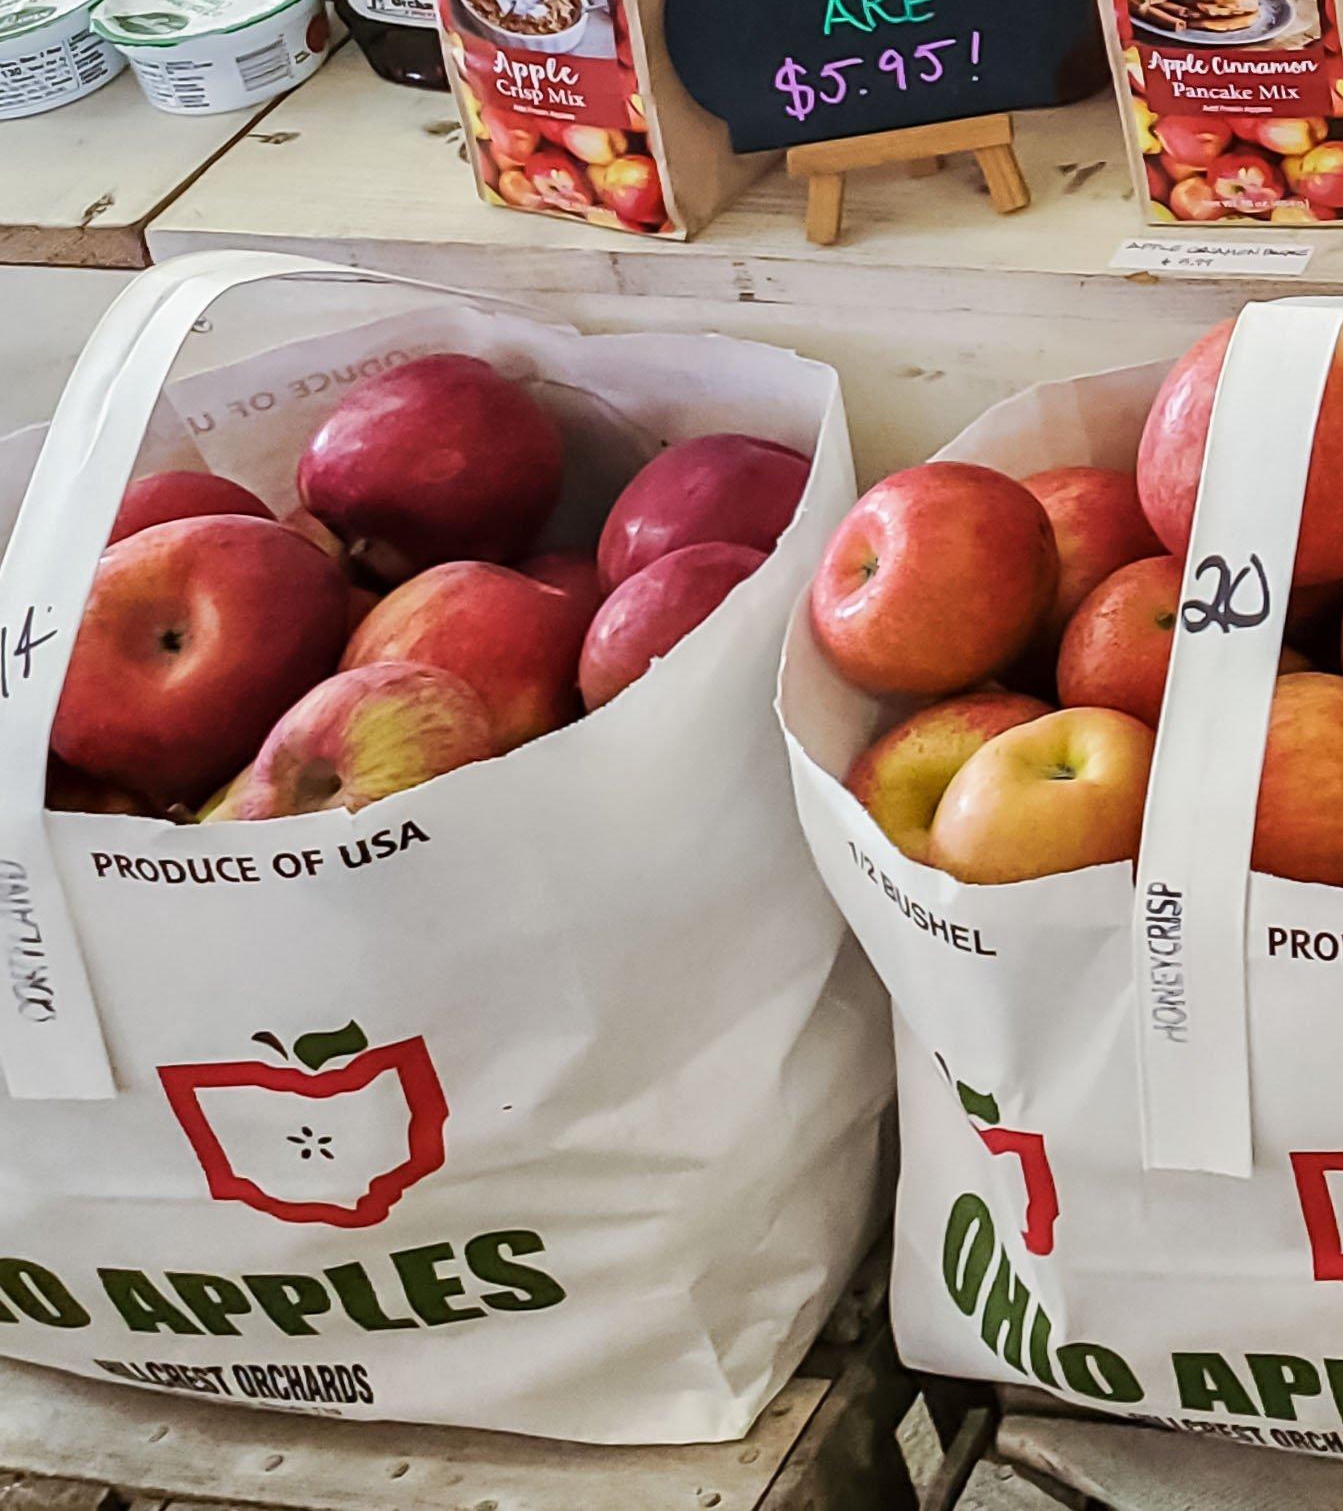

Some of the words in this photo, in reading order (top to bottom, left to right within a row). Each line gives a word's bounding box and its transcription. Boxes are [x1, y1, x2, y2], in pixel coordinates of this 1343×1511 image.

[493, 49, 579, 85] Apple
[496, 80, 544, 105] Crisp
[548, 88, 586, 108] Mix
[1148, 49, 1209, 80] Apple
[1212, 56, 1318, 76] Cinnamon
[1172, 80, 1254, 100] Pancake
[1259, 85, 1300, 100] Mix
[1181, 553, 1270, 633] 20
[91, 851, 261, 884] PRODUCE
[272, 849, 324, 879] OF
[339, 820, 430, 869] USA
[846, 841, 879, 882] 1/2
[878, 875, 997, 957] BUSHEL
[1145, 882, 1189, 1043] HONEYCRISP
[97, 1229, 567, 1336] APPLES
[943, 1193, 1145, 1404] OHIO
[233, 1363, 374, 1404] ORCHARDS
